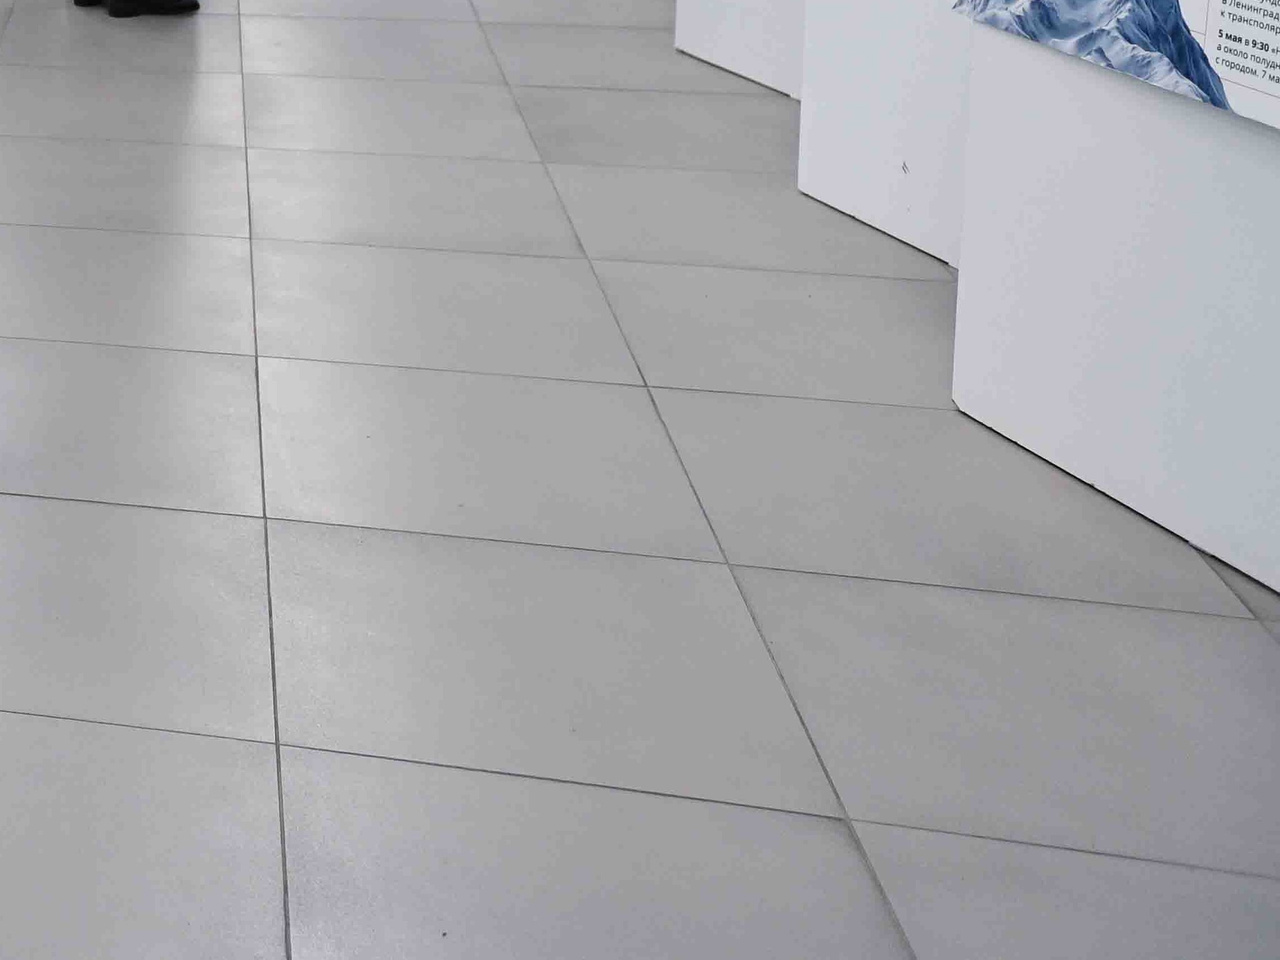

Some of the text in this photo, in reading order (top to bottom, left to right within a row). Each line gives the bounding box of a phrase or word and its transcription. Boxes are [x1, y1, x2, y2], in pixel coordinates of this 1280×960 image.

[1218, 29, 1269, 52] 5 мая 9:30
[1224, 46, 1249, 60] около
[1221, 58, 1267, 79] городом. 7
